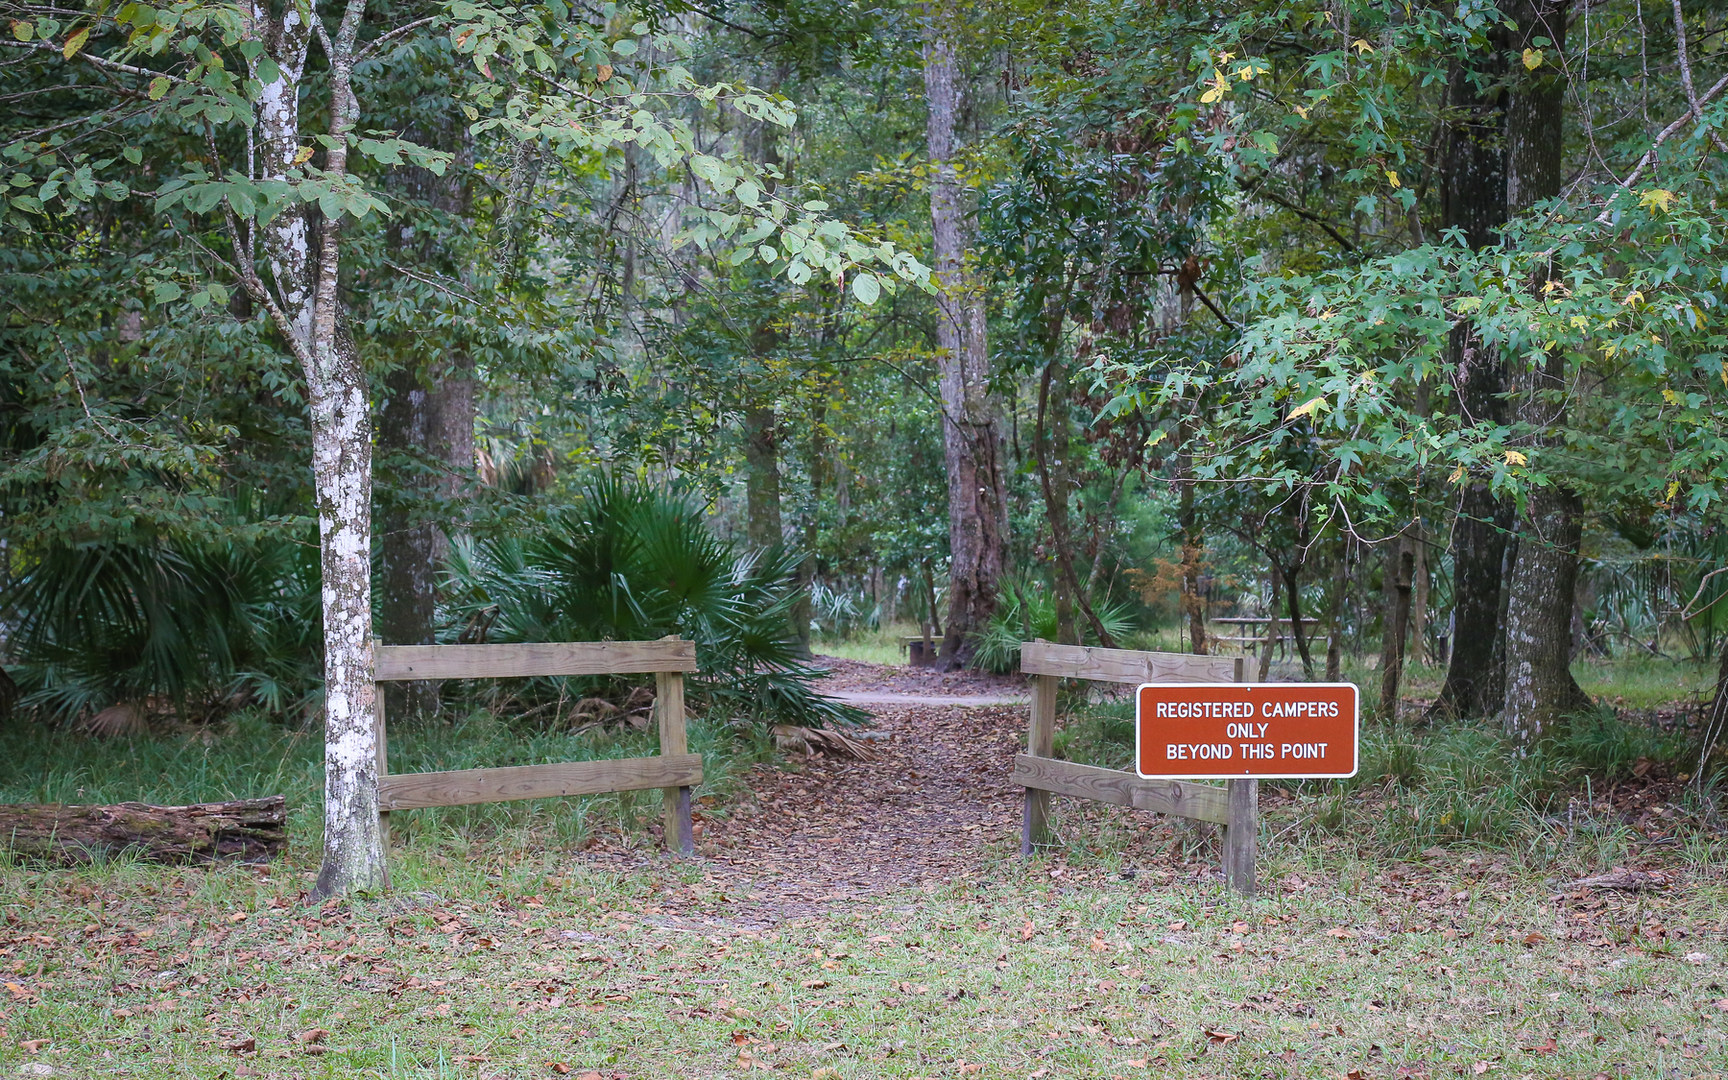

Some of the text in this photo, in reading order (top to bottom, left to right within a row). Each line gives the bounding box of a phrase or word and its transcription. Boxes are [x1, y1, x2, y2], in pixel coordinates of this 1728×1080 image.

[1157, 702, 1338, 718] REGISTERED CAMPERS
[1227, 723, 1268, 738] ONLY
[1167, 743, 1327, 759] BEYOND THIS POINT
